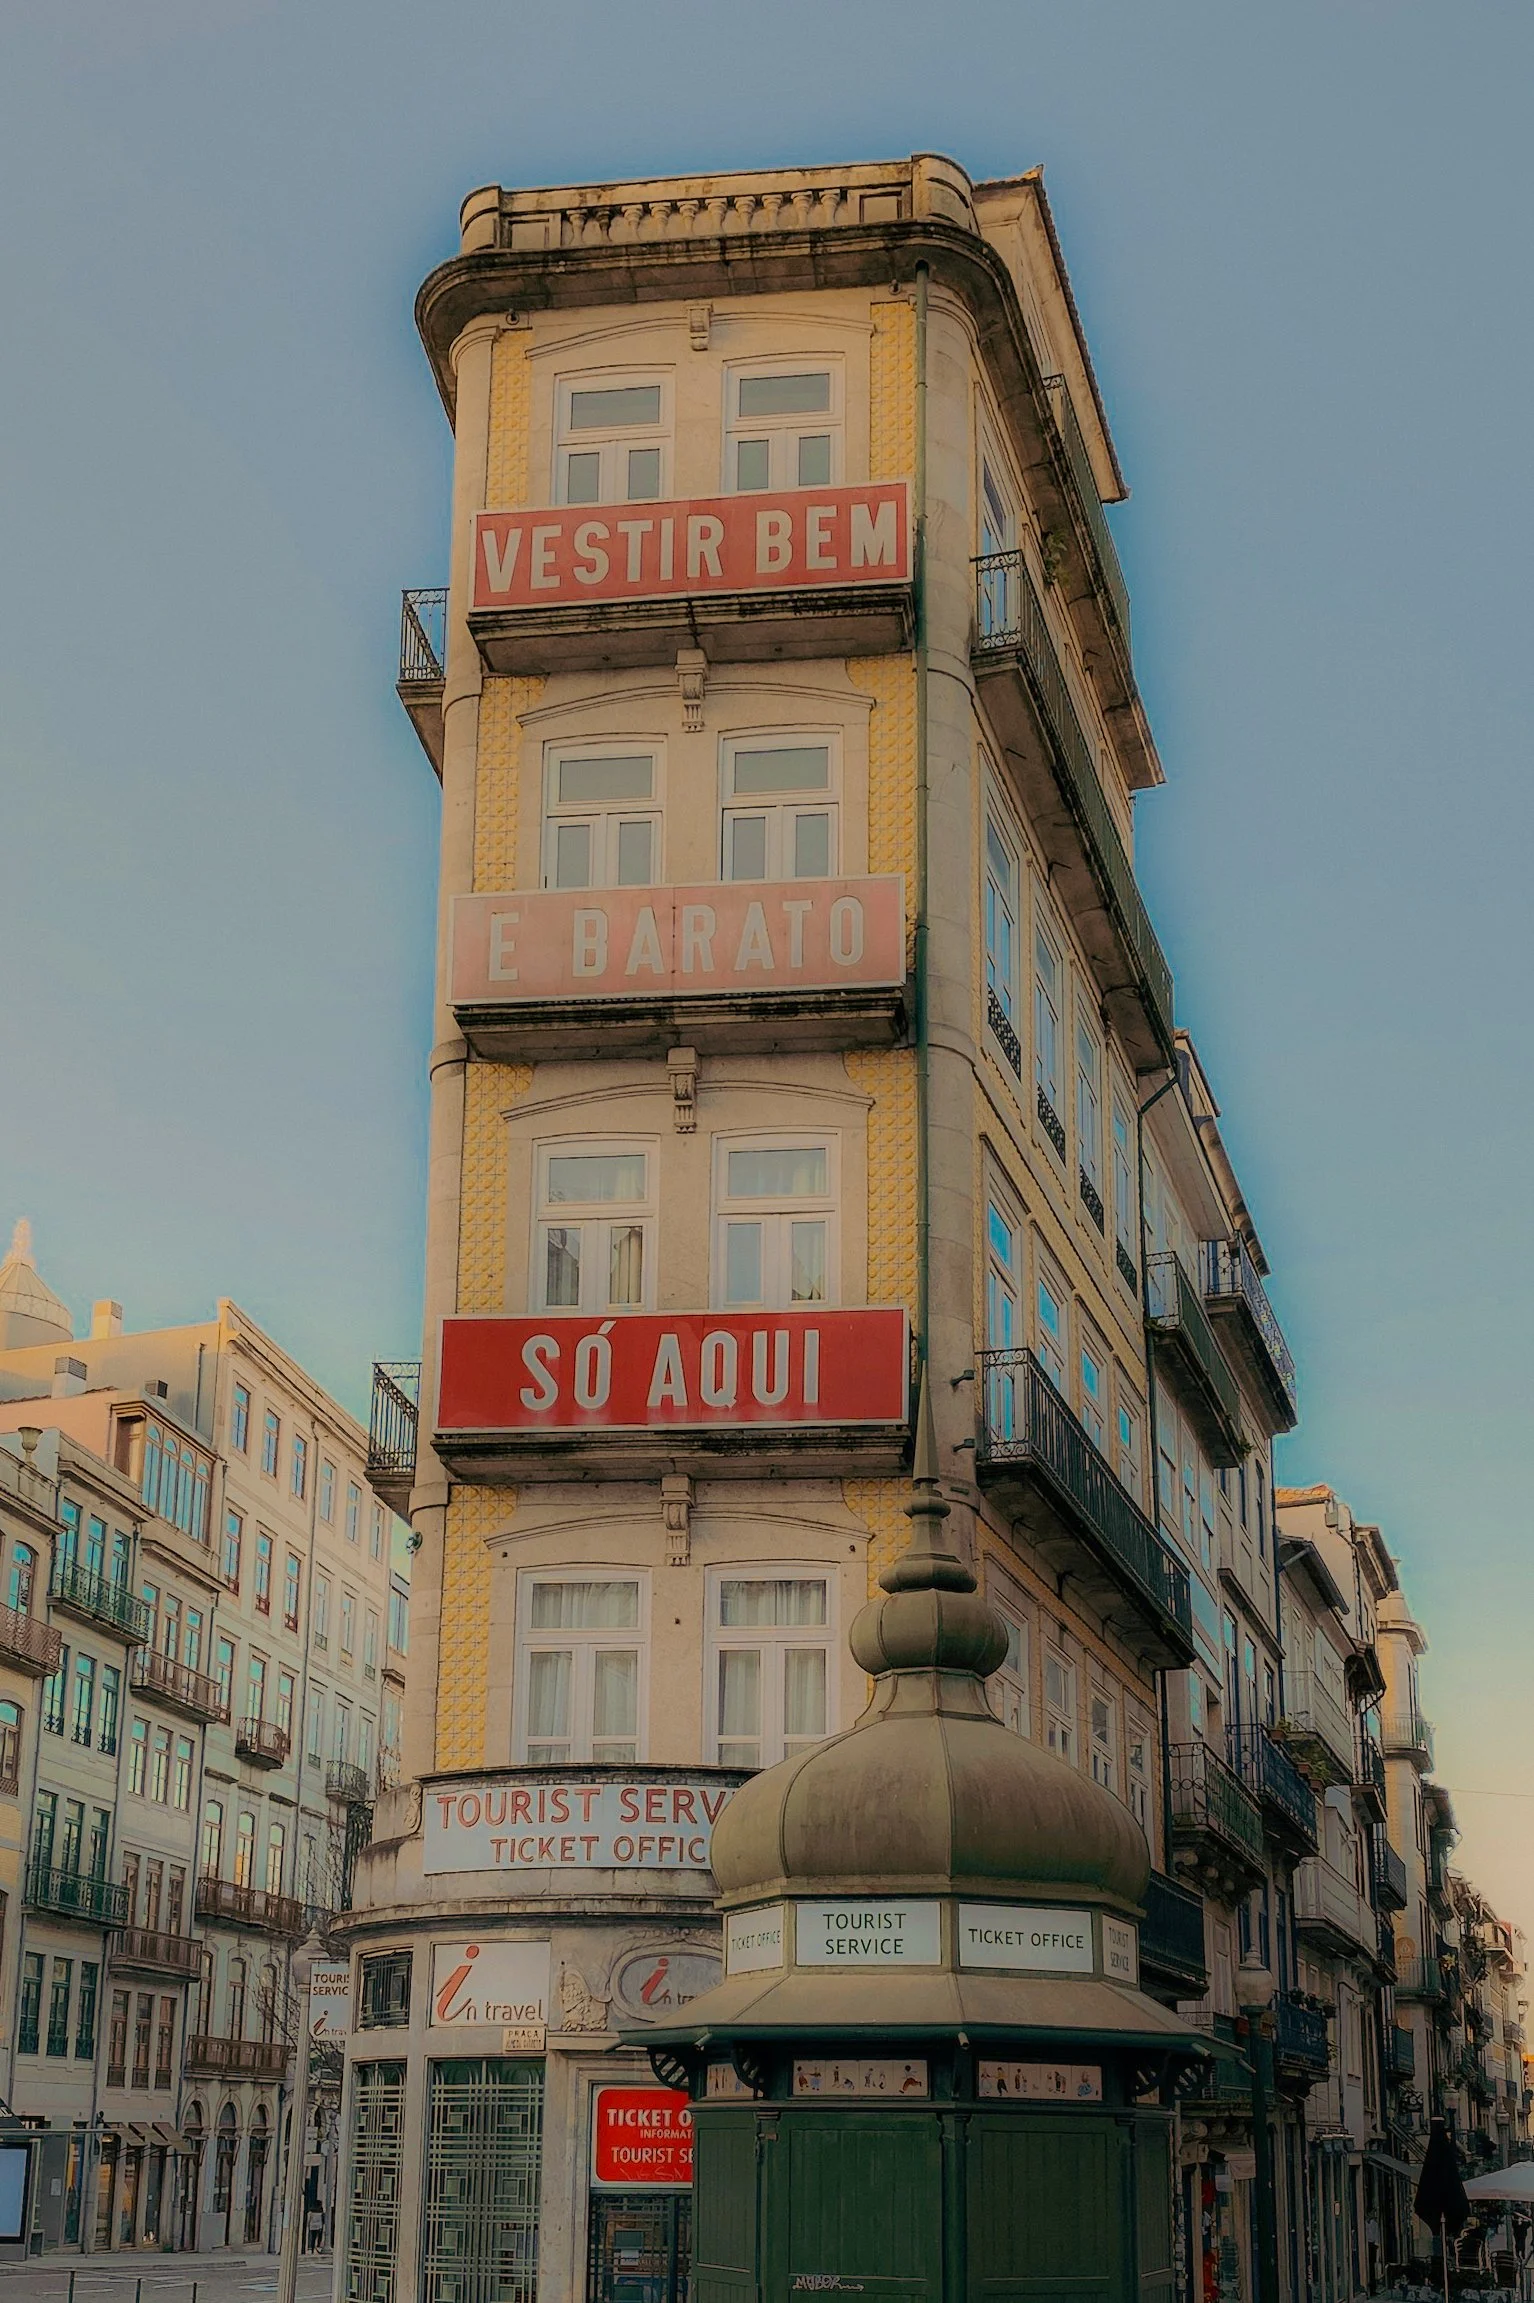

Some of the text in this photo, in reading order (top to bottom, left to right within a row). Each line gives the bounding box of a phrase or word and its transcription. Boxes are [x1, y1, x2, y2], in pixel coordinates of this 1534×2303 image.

[482, 500, 898, 593] VESTIR BEM
[488, 895, 865, 982] E BARATO
[519, 1321, 821, 1412] SÓ AQUI
[437, 1787, 735, 1829] TOURIST SERV
[490, 1836, 706, 1863] TICKET OFFIC
[822, 1913, 907, 1930] TOURIST
[731, 1930, 781, 1951] TICKET OFFICE
[825, 1938, 904, 1955] SERVICE
[968, 1928, 1084, 1949] TICKET OFFICE
[1109, 1926, 1129, 1949] TOURIST
[1110, 1952, 1129, 1972] SERVICE
[313, 1986, 349, 1996] SERVIC
[485, 1999, 544, 2021] travel
[607, 2108, 672, 2127] TICKET
[611, 2146, 674, 2163] TOURIST
